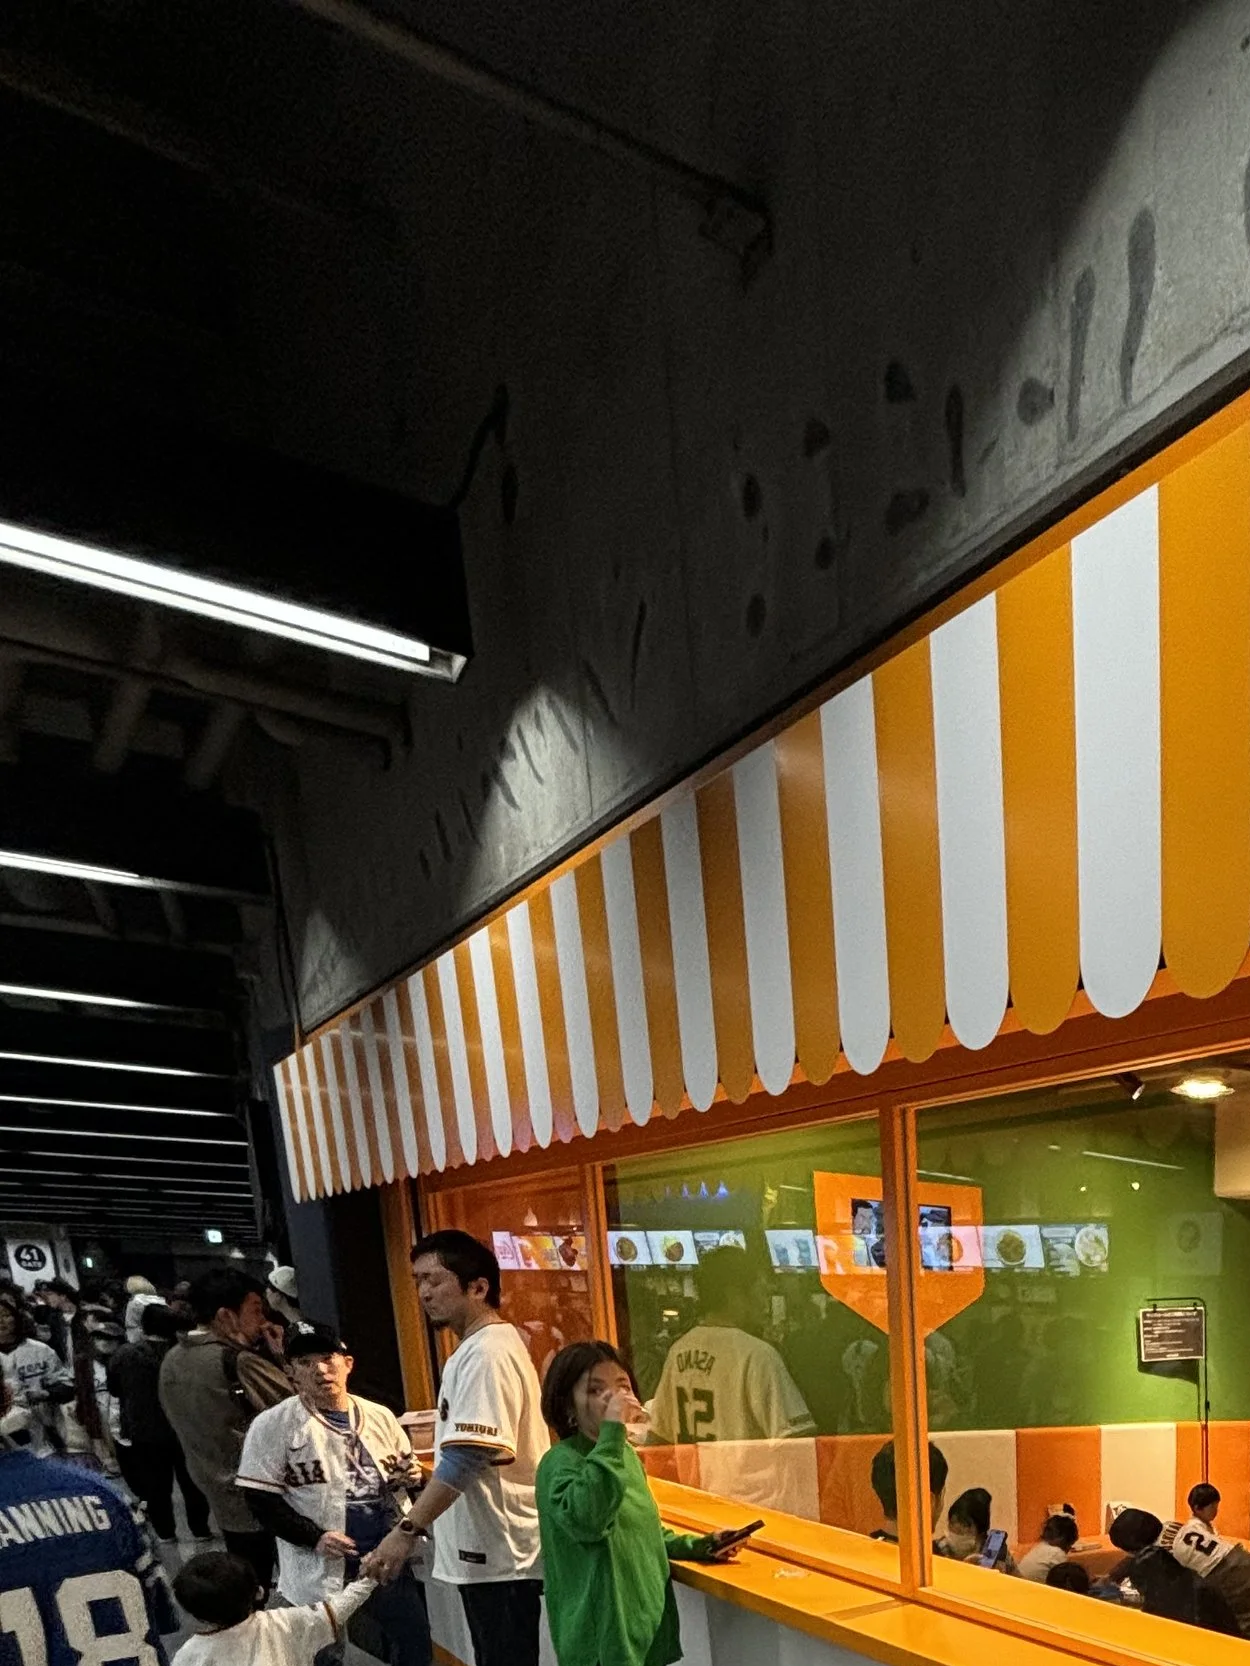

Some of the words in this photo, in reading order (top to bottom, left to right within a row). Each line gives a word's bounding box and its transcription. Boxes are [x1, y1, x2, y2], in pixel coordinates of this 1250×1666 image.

[20, 1247, 39, 1261] 41
[455, 1423, 498, 1437] YOMIURI
[1183, 1531, 1218, 1557] 2
